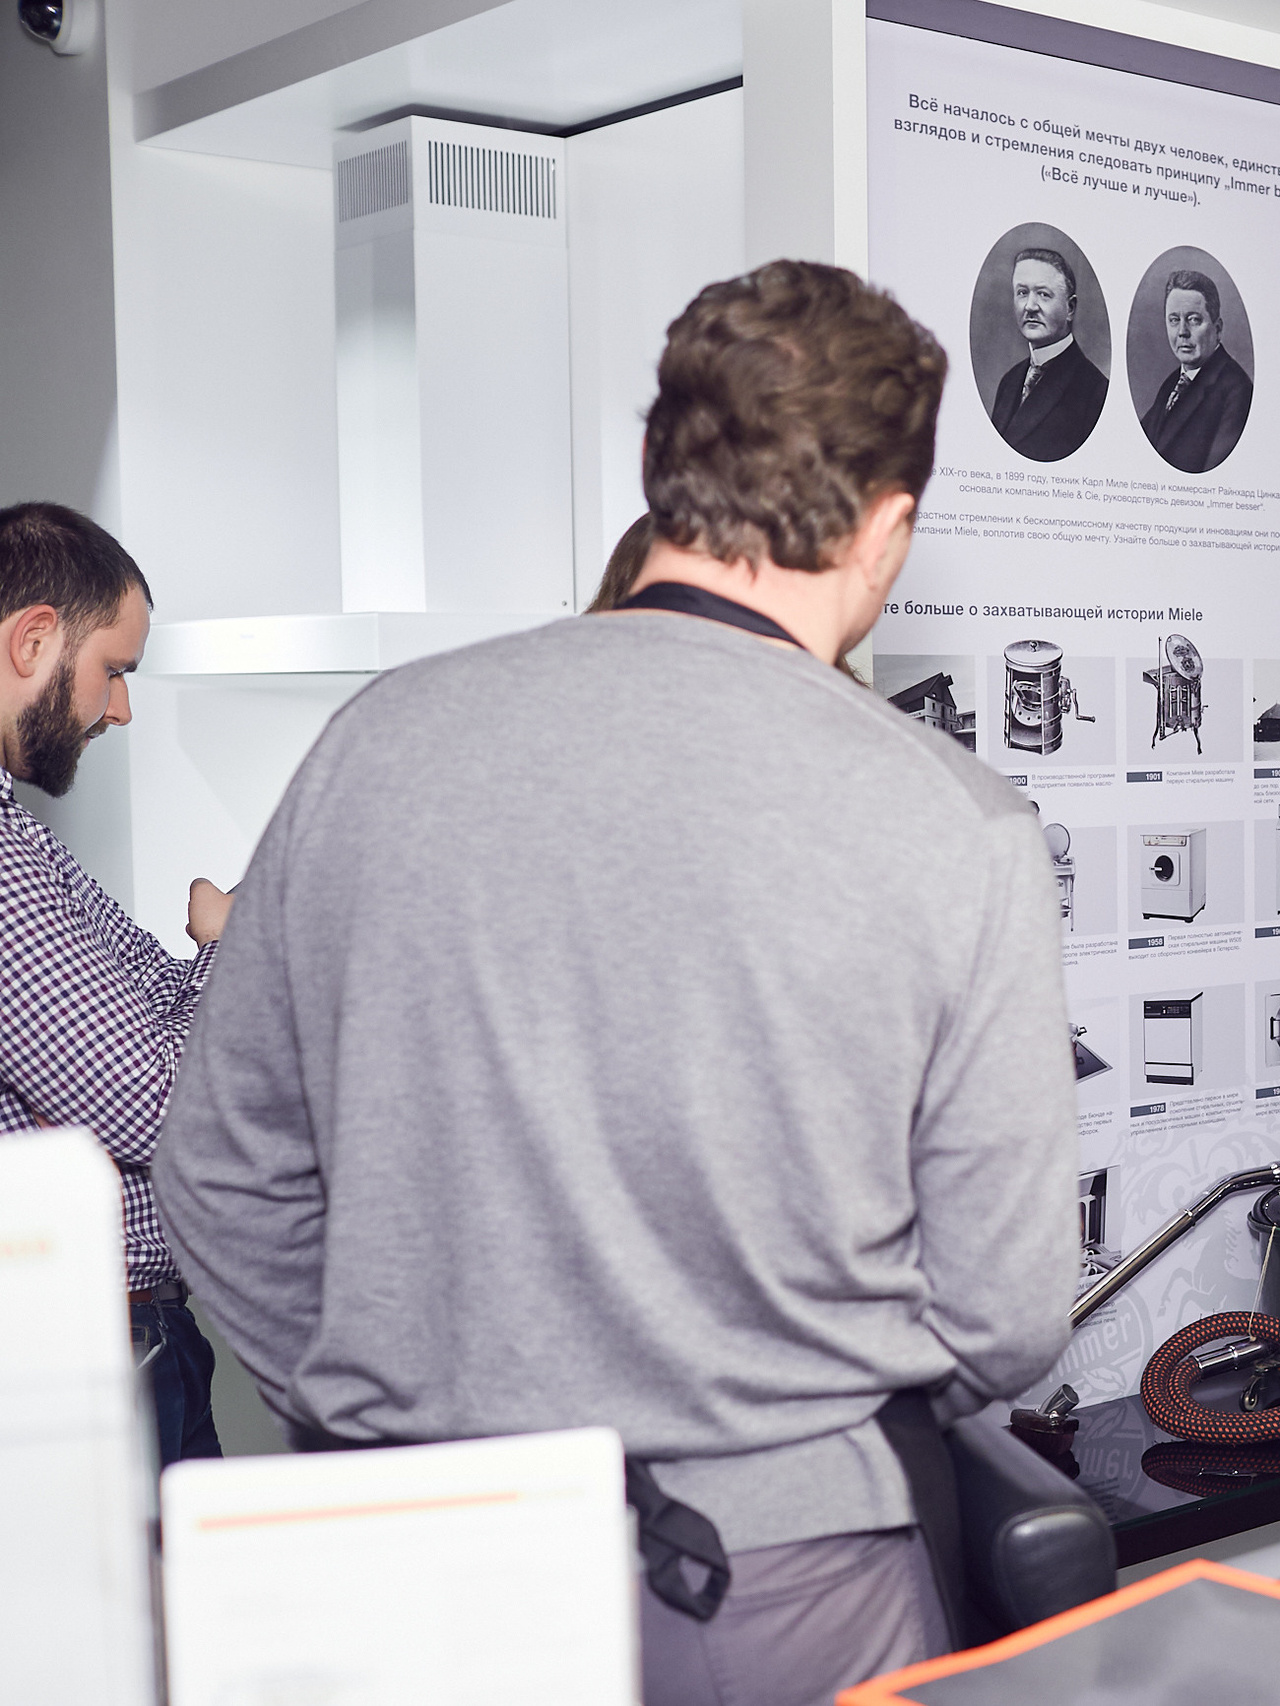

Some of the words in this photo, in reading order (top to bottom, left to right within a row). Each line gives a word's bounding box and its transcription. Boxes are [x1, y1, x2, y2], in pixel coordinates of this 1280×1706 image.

[908, 92, 939, 113] Всё
[943, 103, 1016, 127] началось
[1019, 117, 1029, 129] с
[1032, 118, 1081, 139] общей
[1085, 129, 1130, 148] мечты
[1133, 139, 1166, 156] двух
[1169, 145, 1228, 168] человек,
[893, 118, 967, 142] взглядов
[971, 132, 980, 144] и
[984, 134, 1074, 161] стремления
[1078, 151, 1153, 174] следовать
[1156, 165, 1221, 189] принципу
[1082, 175, 1128, 193] лучше
[1132, 183, 1140, 195] и
[916, 508, 956, 523] растном
[912, 522, 952, 536] омпании
[904, 599, 964, 616] больше
[968, 605, 978, 616] о
[982, 604, 1103, 621] захватывающей
[1107, 608, 1164, 623] истории
[1168, 607, 1203, 622] Miele
[1145, 772, 1161, 781] 1901
[1147, 937, 1163, 947] 1958
[1149, 1104, 1165, 1113] 1978
